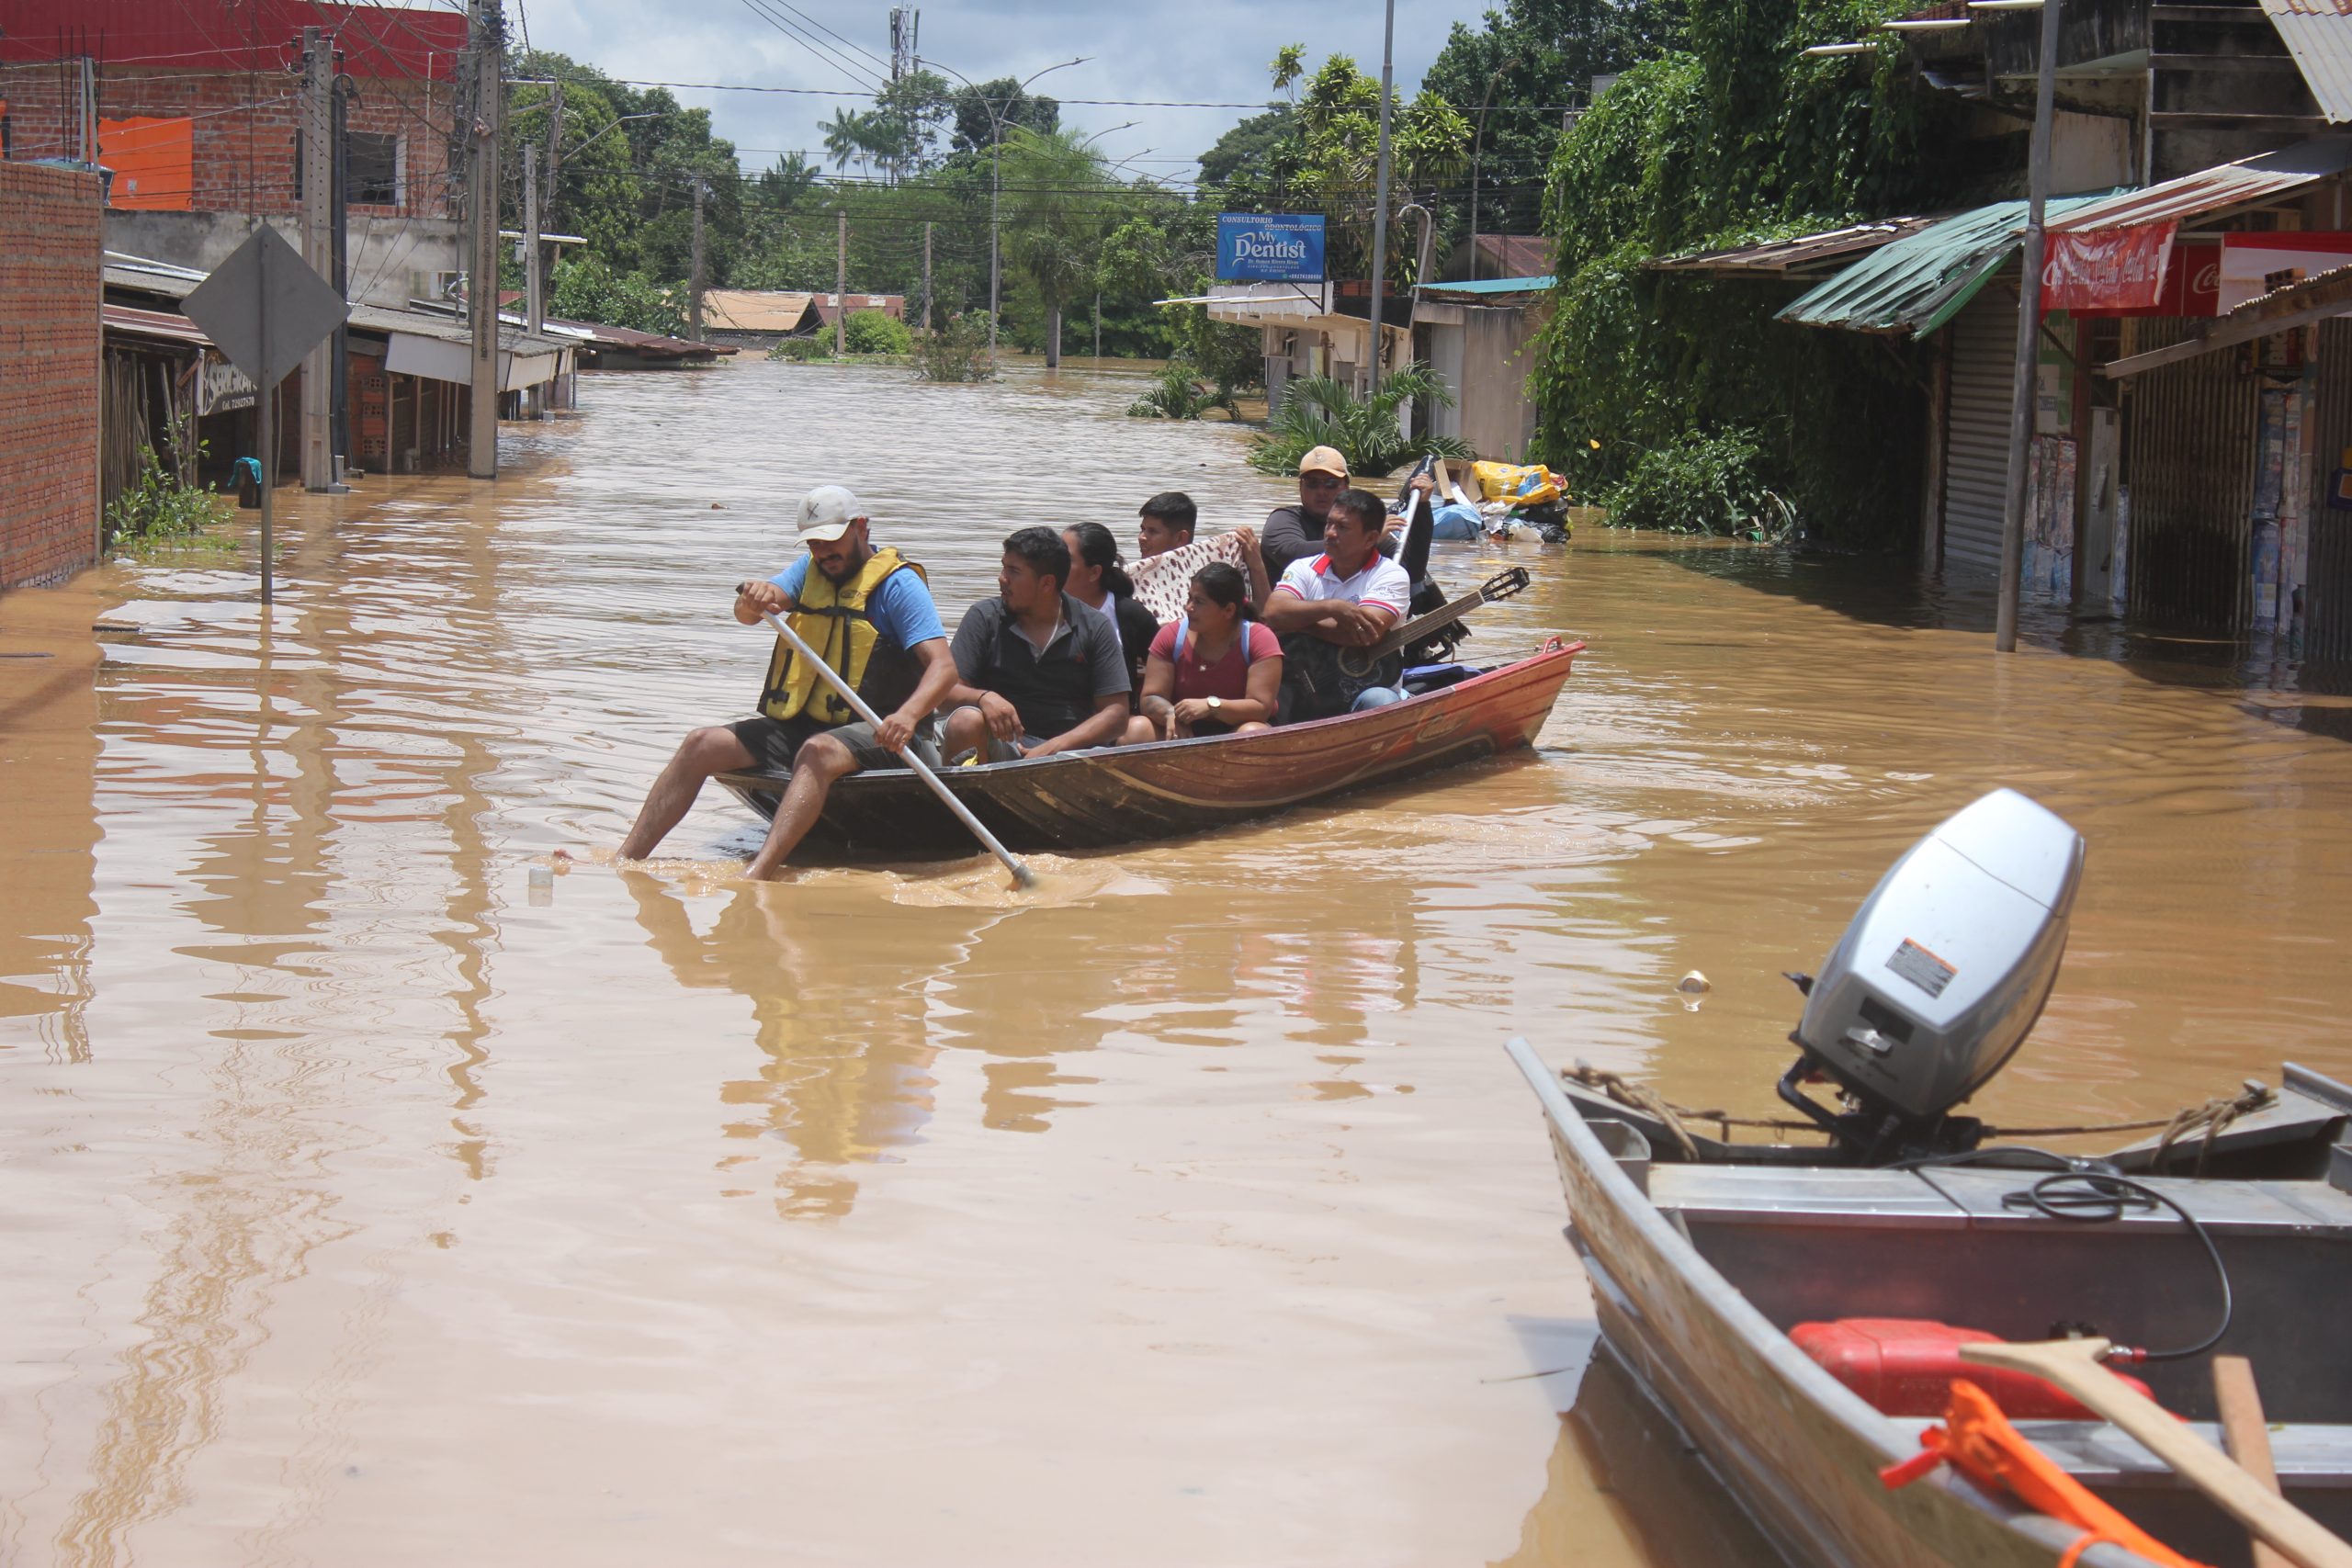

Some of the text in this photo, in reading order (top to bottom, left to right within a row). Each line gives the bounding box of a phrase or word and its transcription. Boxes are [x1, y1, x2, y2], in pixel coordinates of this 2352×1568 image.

[1222, 216, 1273, 224] CONSULTORIO
[1259, 231, 1277, 244] My
[1236, 239, 1306, 259] Dentist
